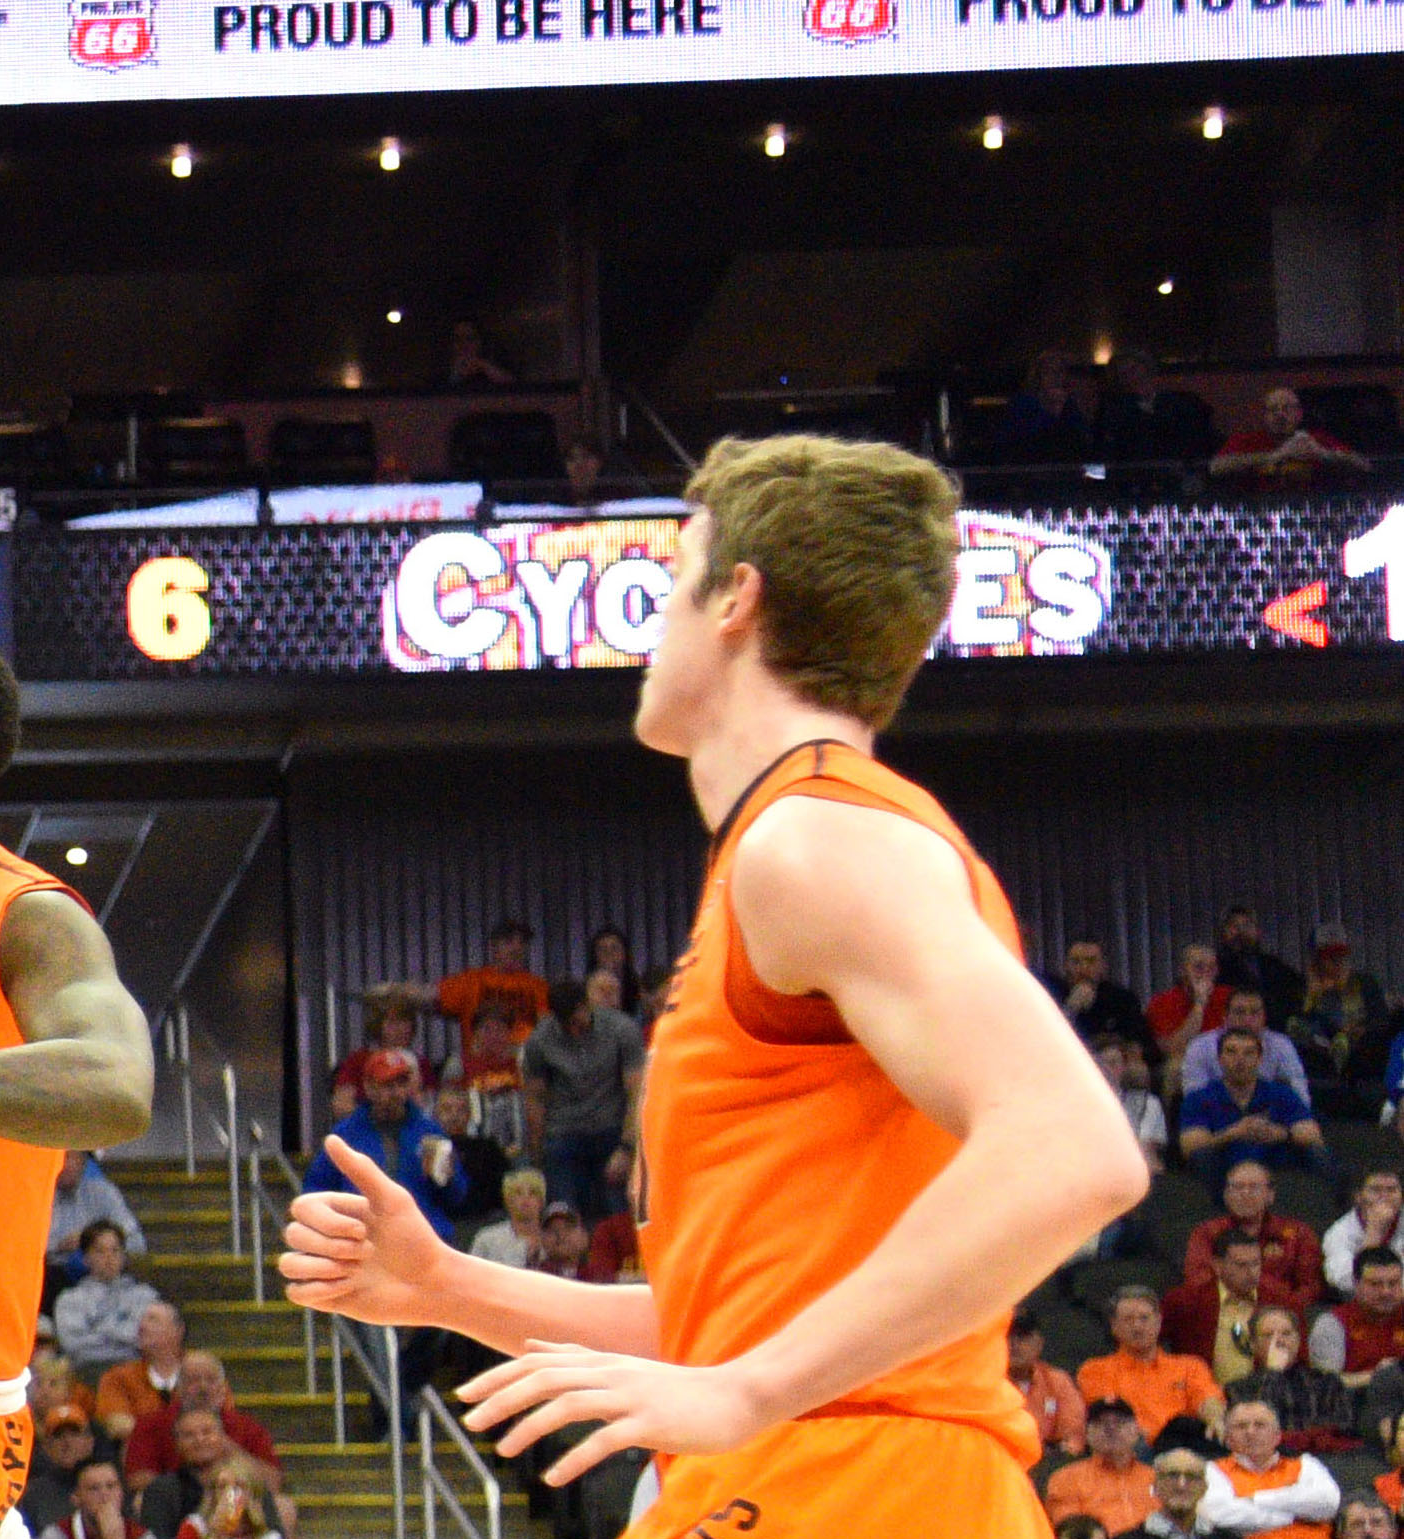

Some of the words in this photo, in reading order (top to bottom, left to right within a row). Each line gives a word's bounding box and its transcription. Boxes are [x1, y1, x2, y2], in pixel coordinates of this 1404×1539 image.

[85, 25, 145, 54] 66
[213, 0, 392, 53] PROUD
[406, 0, 478, 48] TO
[496, 0, 563, 43] BE
[584, 0, 721, 41] HERE
[127, 556, 210, 662] 6
[395, 530, 1104, 658] CYCES
